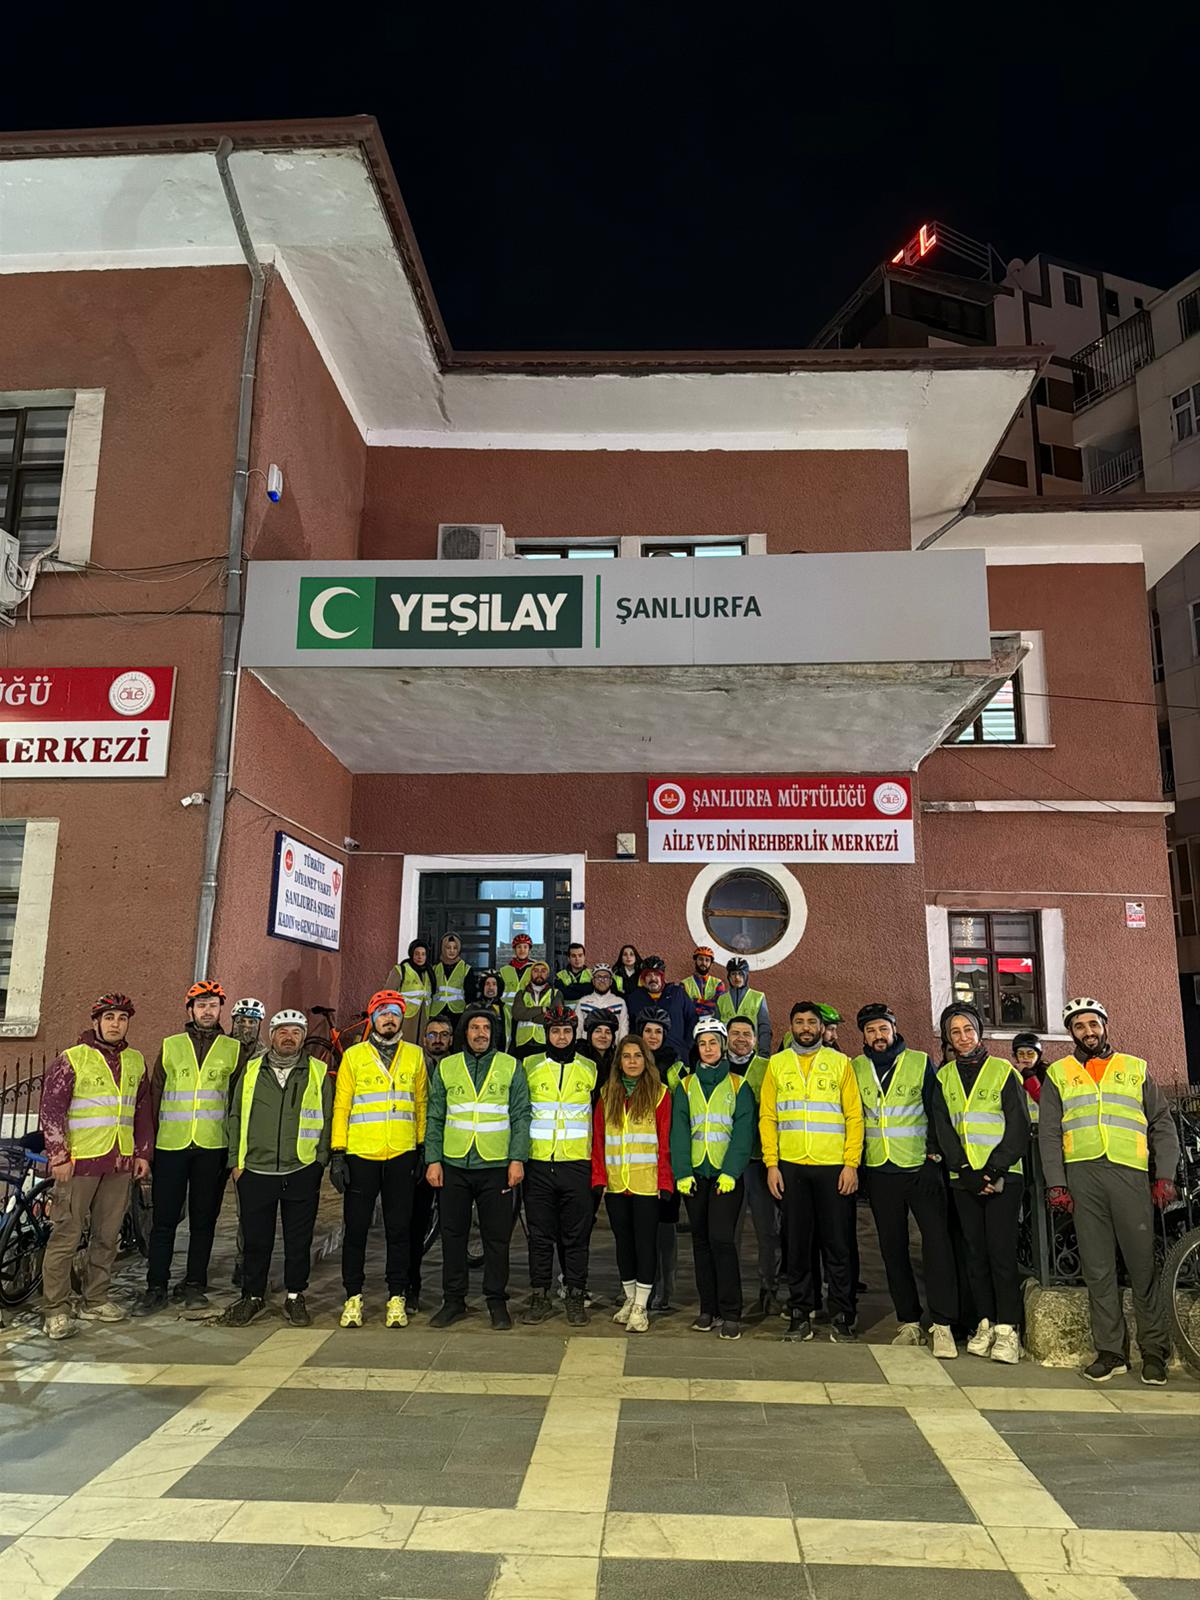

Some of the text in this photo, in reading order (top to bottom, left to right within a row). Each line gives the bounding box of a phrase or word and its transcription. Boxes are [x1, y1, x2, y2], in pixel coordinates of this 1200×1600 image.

[390, 592, 568, 636] YEŞİLAY
[615, 595, 762, 624] ŞANLIURFA
[0, 675, 53, 706] ĞÜ
[692, 784, 867, 812] ŞANLIURFA MÜFTÜLÜĞÜ
[662, 829, 899, 851] AİLE VE DİNİ REHBERLİK MERKEZİ
[303, 853, 326, 875] TÜRKİYE
[294, 869, 317, 891] DİYANET
[285, 888, 319, 913] ŞANLIURFA
[277, 911, 295, 930] KADIN
